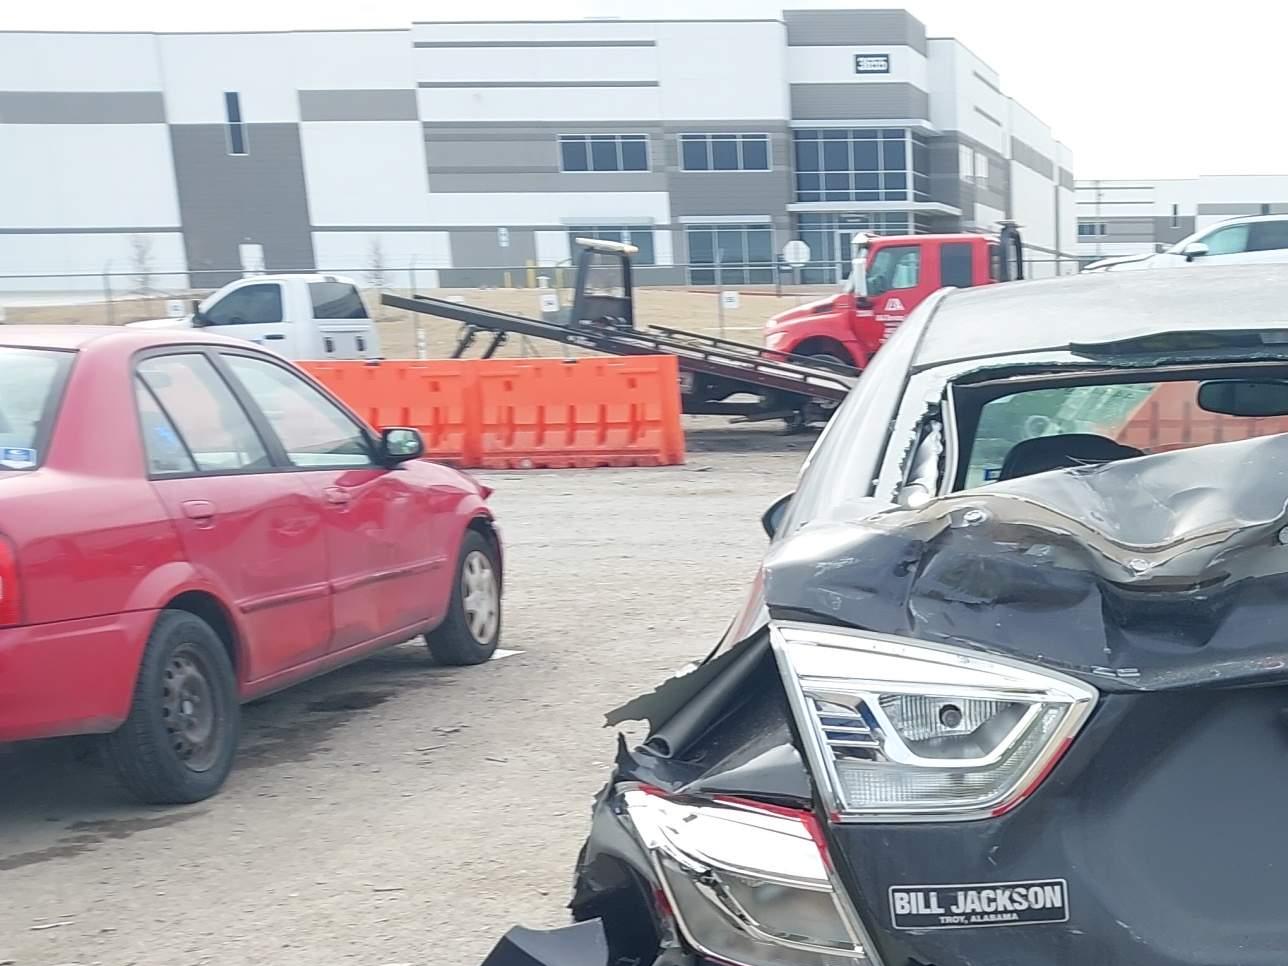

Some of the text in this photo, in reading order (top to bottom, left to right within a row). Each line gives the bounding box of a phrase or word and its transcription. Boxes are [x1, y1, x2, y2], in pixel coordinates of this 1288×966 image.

[894, 886, 1062, 914] BILL JACKSON
[970, 913, 1019, 922] ALABAMA
